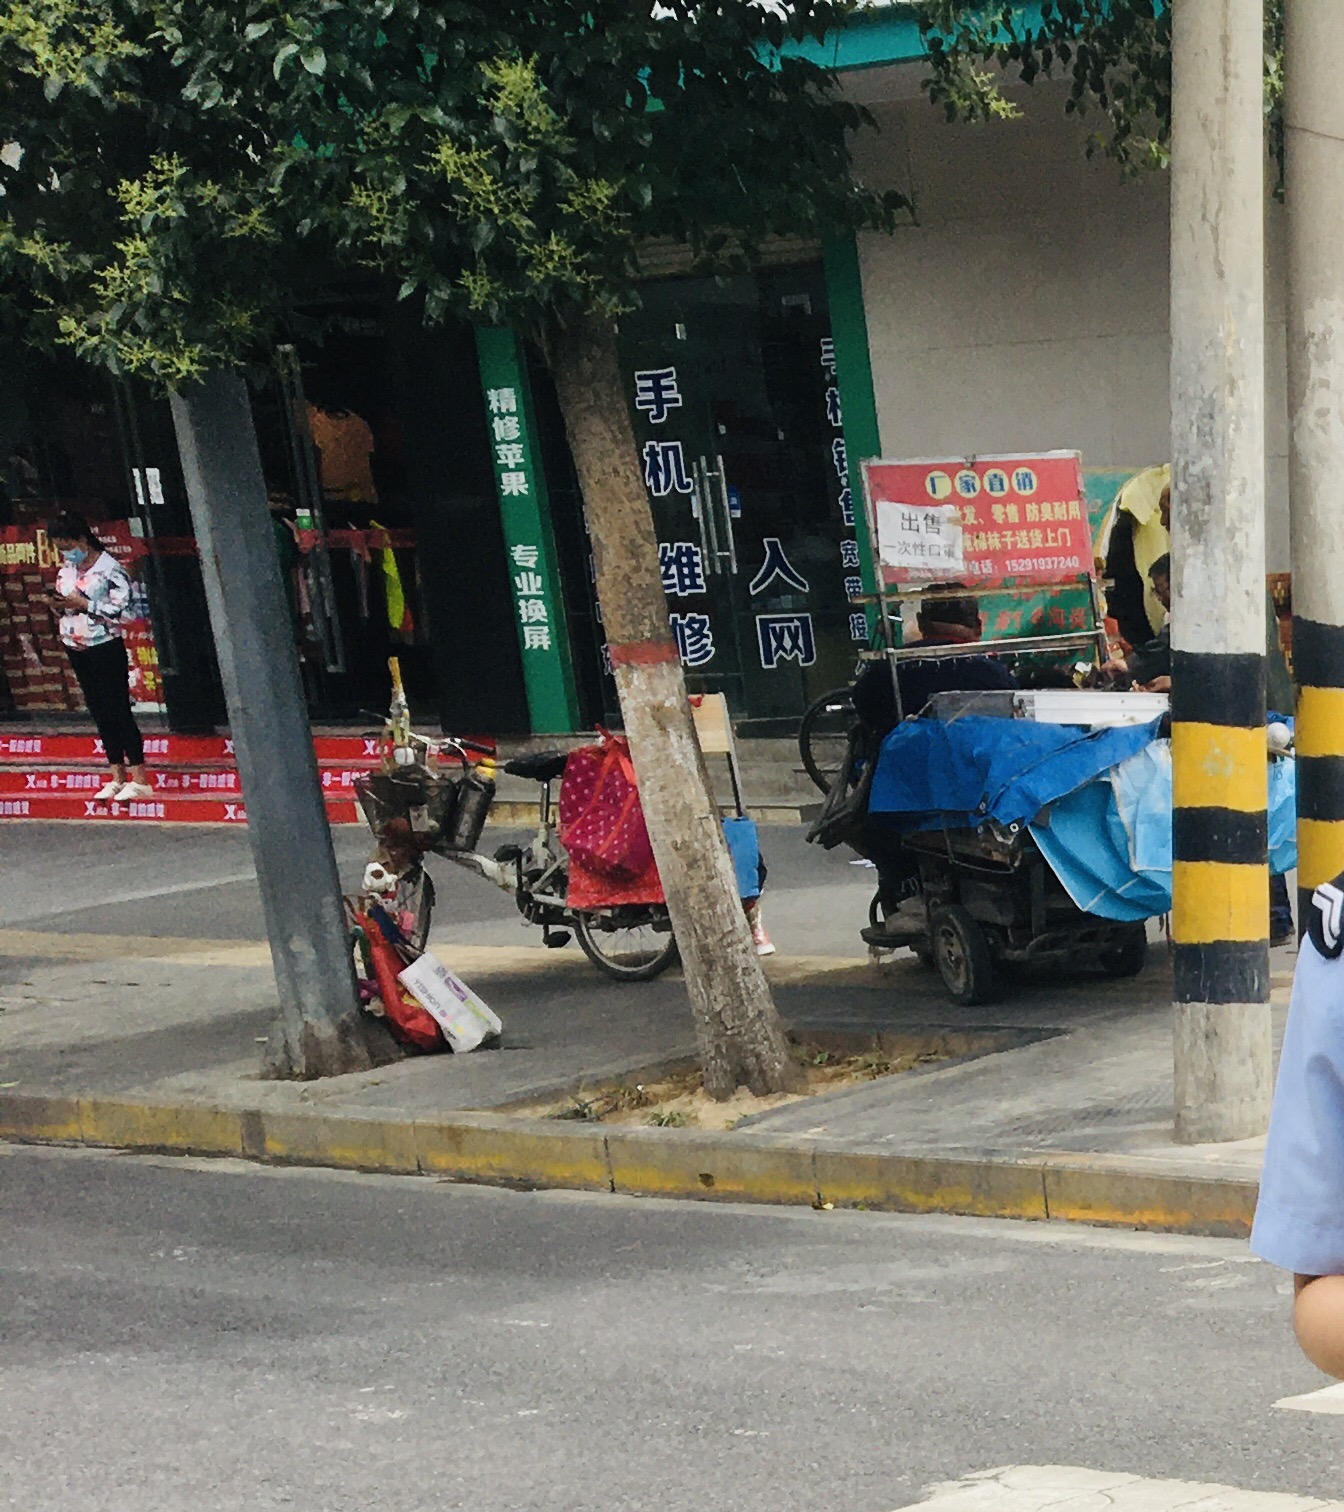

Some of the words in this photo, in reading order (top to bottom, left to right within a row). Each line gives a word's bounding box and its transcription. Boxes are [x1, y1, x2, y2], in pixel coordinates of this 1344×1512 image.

[486, 387, 529, 497] 精修苹果
[510, 544, 552, 651] 专业换屏
[928, 471, 1035, 495] 厂家直销
[901, 512, 941, 535] 出售
[1005, 555, 1080, 572] 15291937240
[658, 542, 716, 667] 维修
[749, 538, 816, 669] 入网
